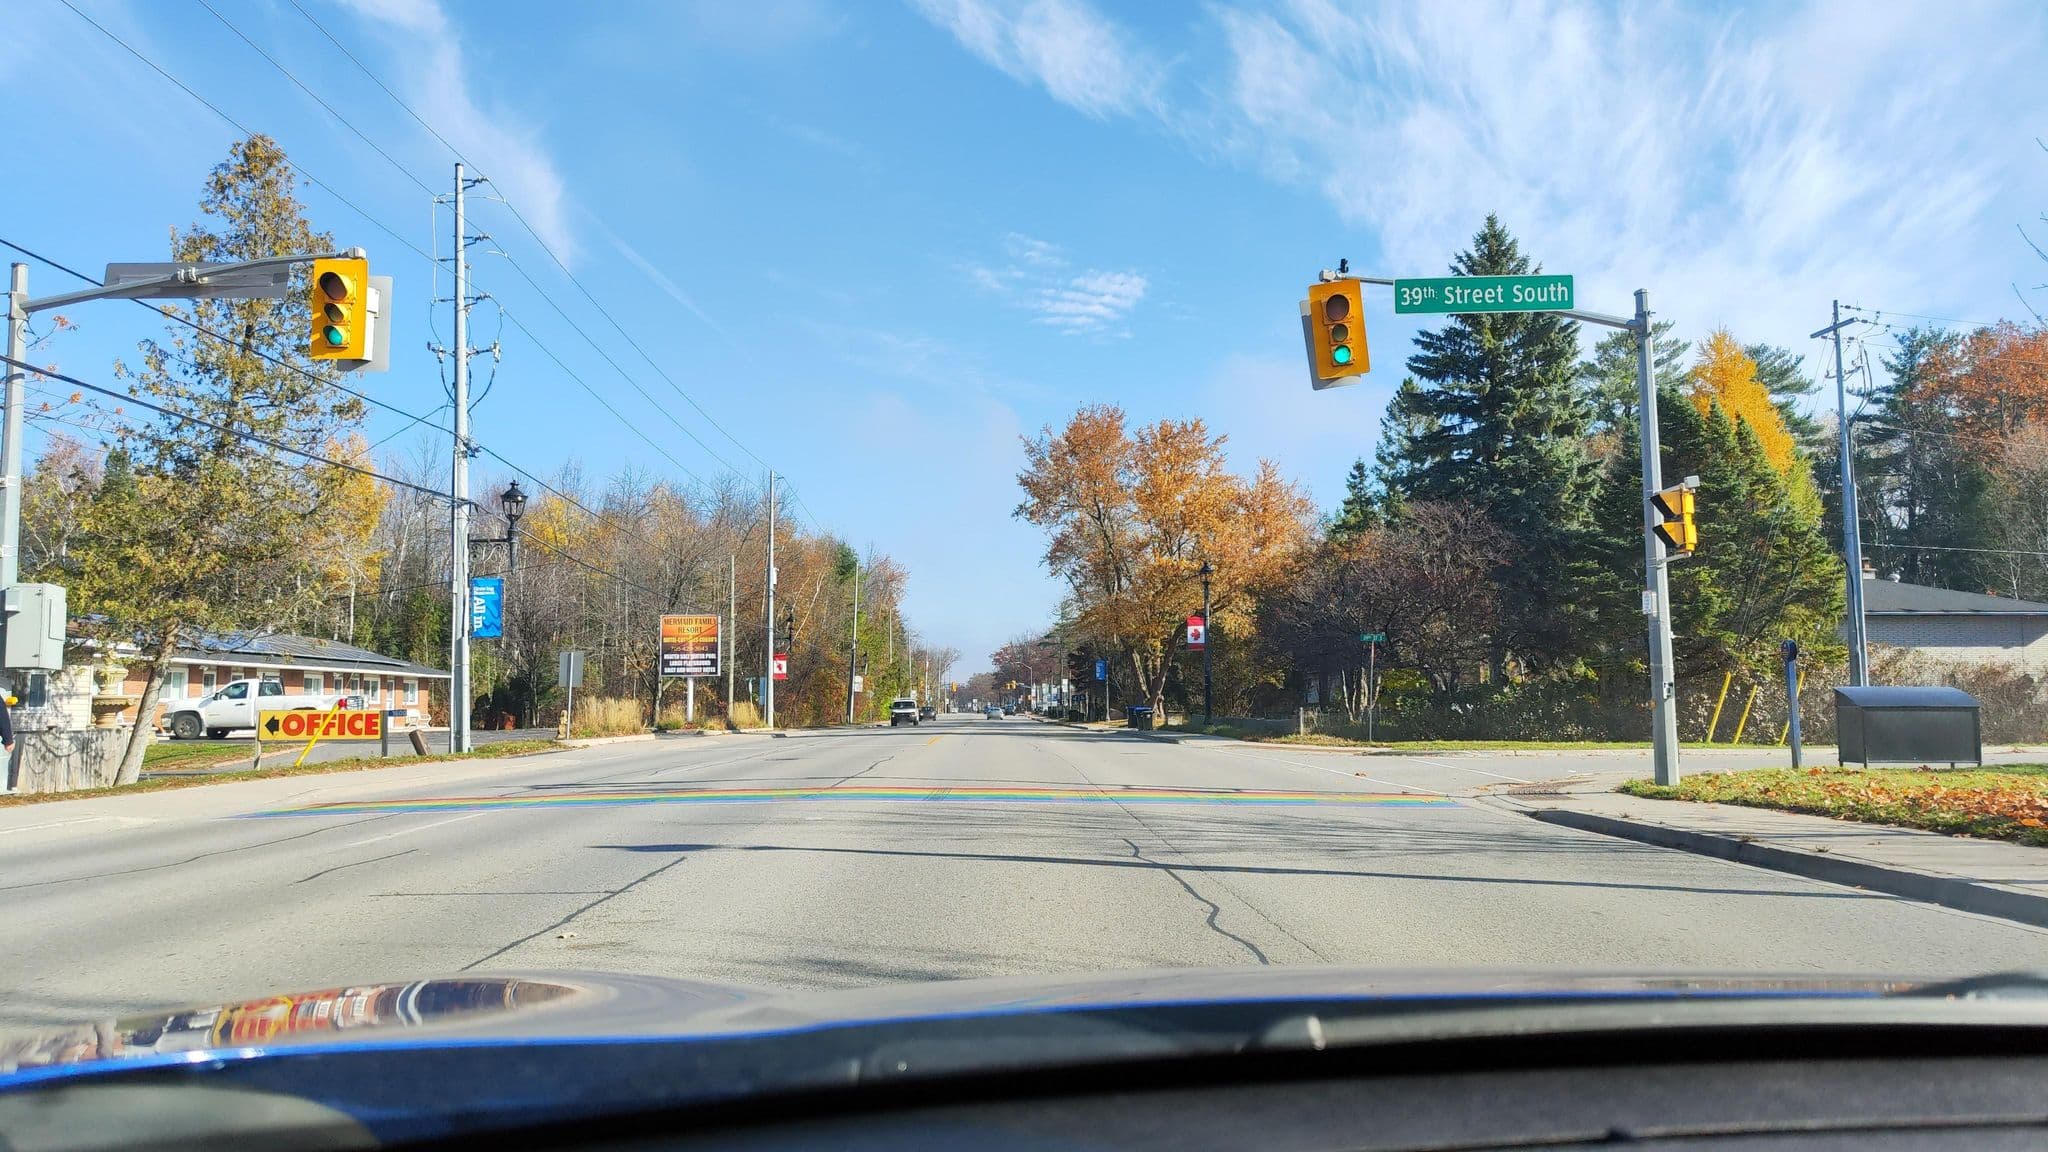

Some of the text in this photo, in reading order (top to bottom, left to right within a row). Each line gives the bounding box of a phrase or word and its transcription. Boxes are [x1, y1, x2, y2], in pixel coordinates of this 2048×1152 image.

[1400, 282, 1569, 306] 39th Street South
[281, 713, 380, 736] OFFICE
